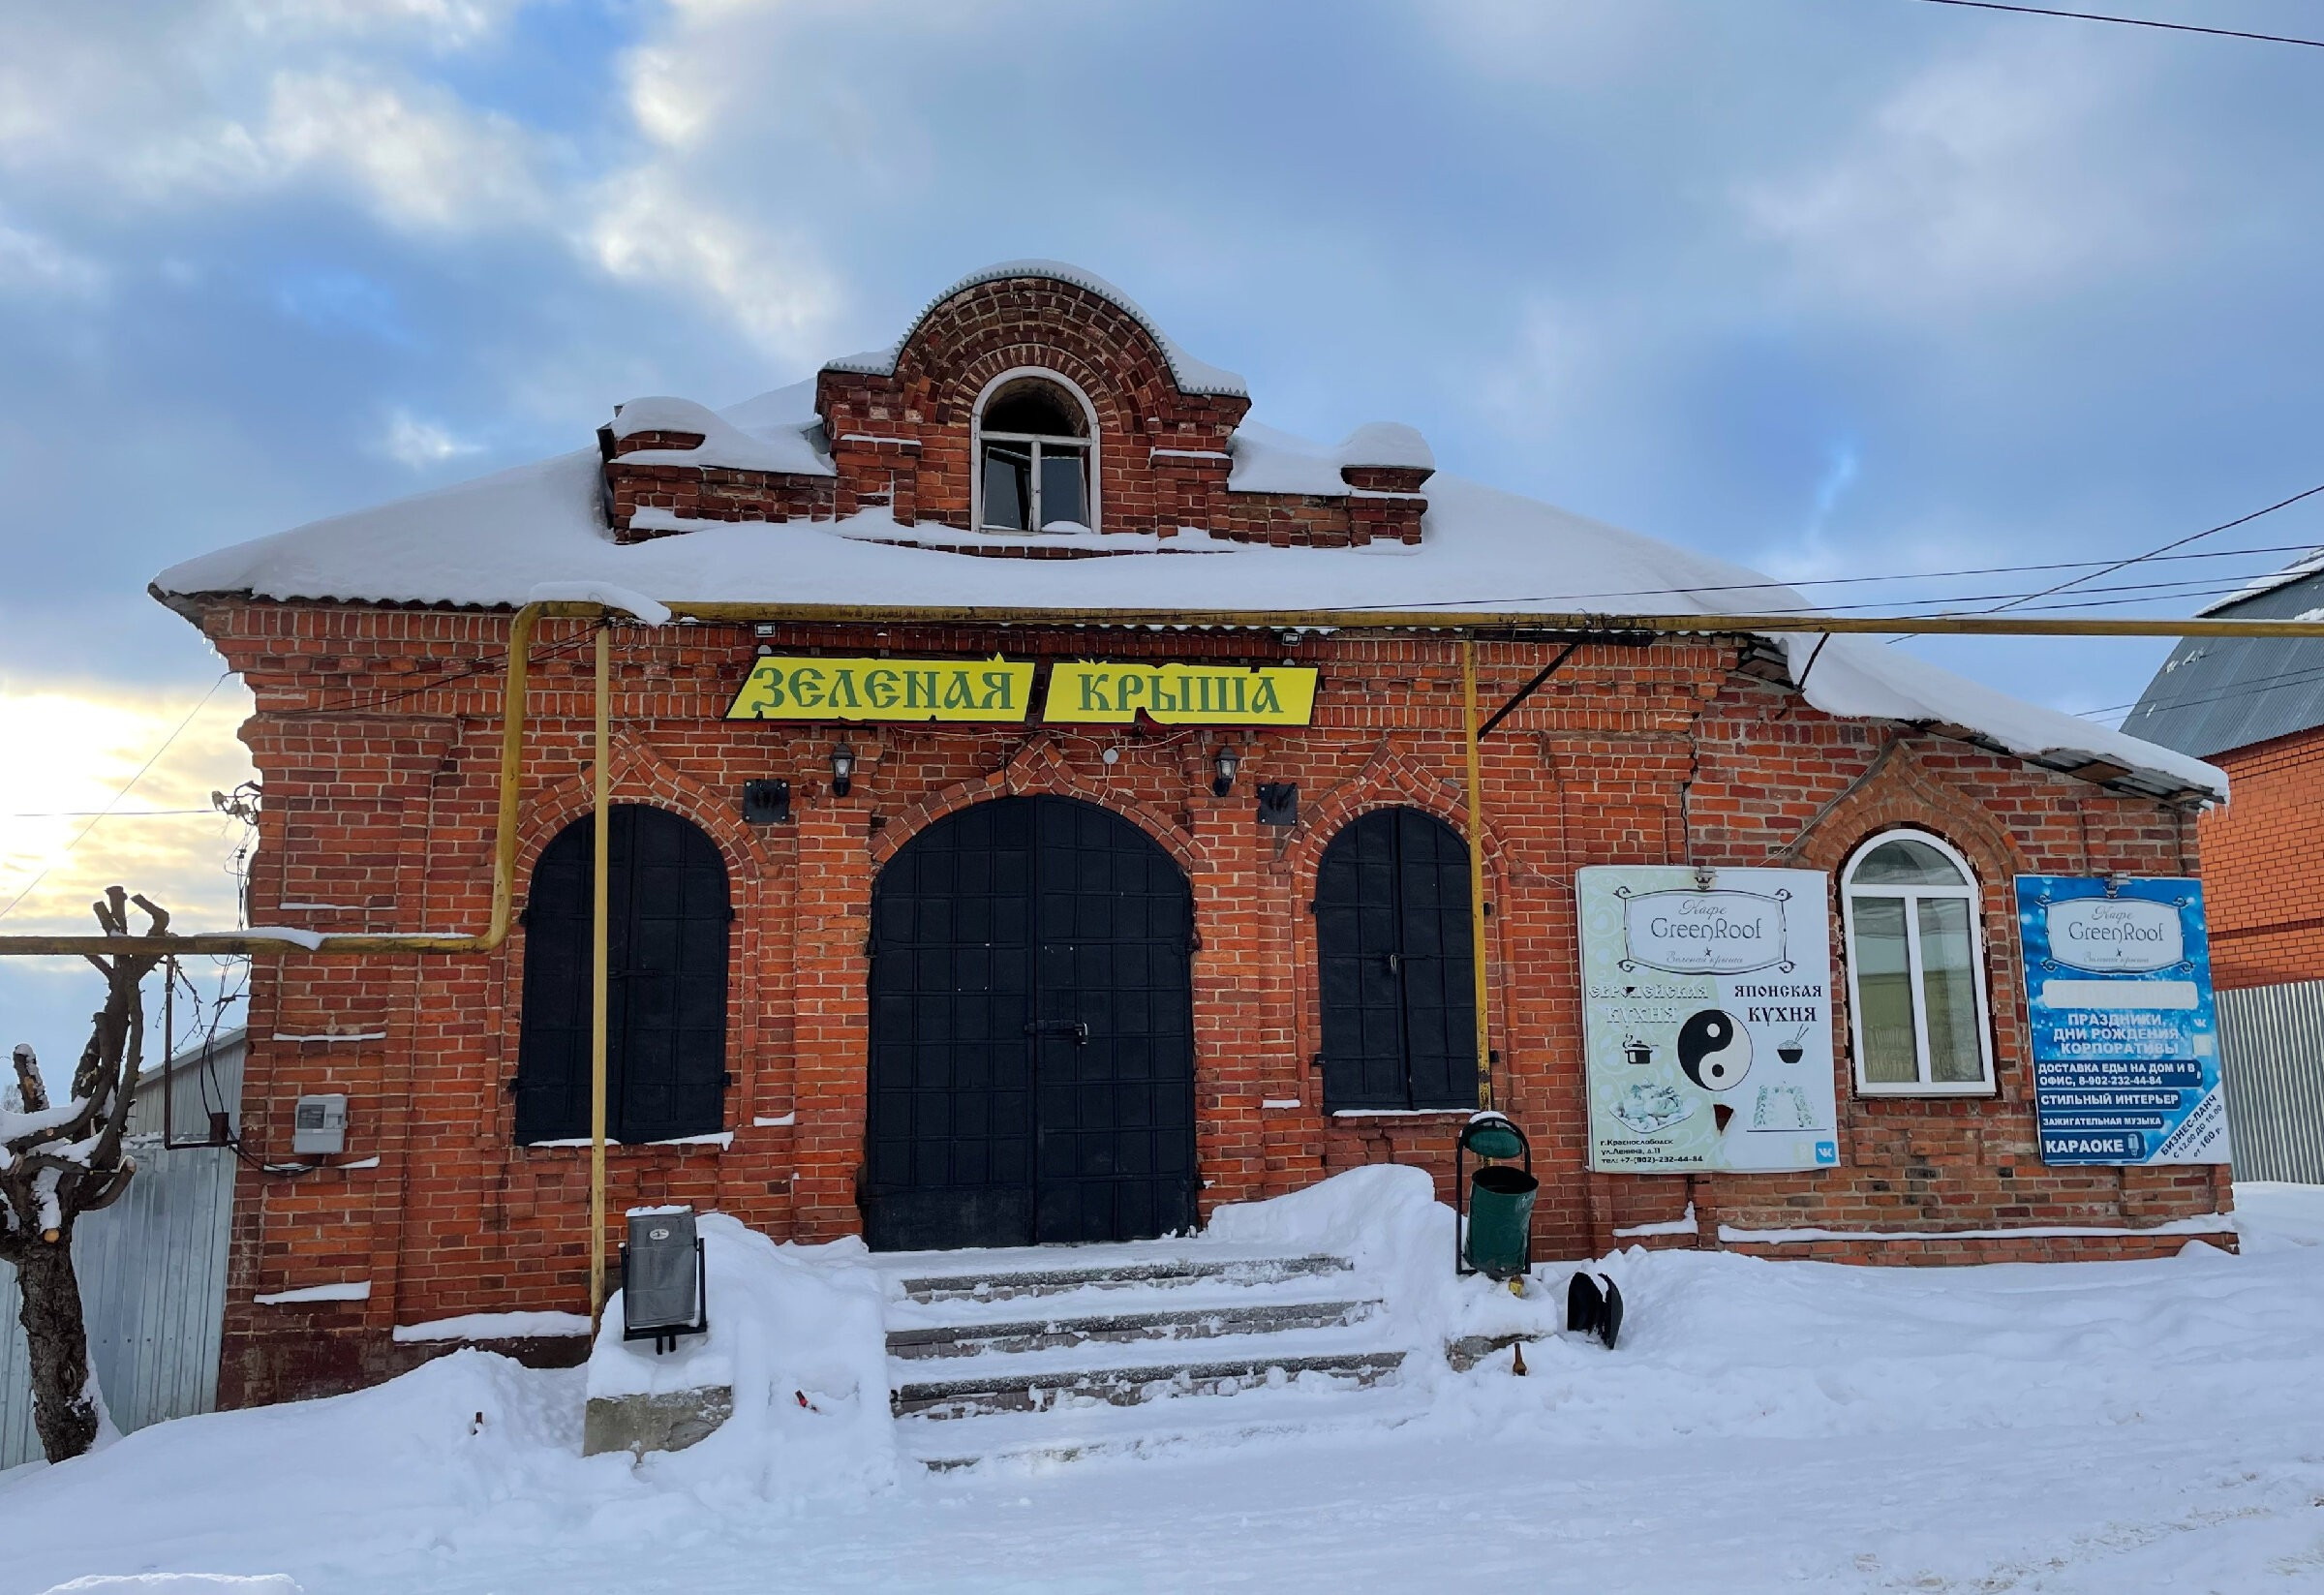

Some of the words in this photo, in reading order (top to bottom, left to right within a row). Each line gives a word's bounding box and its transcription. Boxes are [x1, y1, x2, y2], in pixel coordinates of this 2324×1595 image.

[751, 666, 1015, 712] ЗЕЛЕНАЯ
[1078, 673, 1284, 714] КРЫША
[1679, 900, 1728, 920] Кафе
[2092, 905, 2136, 924] Кафе
[1650, 917, 1763, 942] GreenRoof
[2068, 922, 2164, 943] GreenRoof
[1734, 985, 1822, 998] ЯПОНСКАЯ
[1747, 1007, 1818, 1027] КУХНЯ
[2053, 1028, 2087, 1042] ДНИ
[2061, 1043, 2179, 1055] КОРПОРАТИВЫ
[2038, 1063, 2099, 1074] ДОСТАВКА
[2102, 1063, 2127, 1074] ЕДЫ
[2130, 1063, 2146, 1073] НА
[2149, 1063, 2174, 1074] ДОМ
[2177, 1063, 2186, 1073] И
[2187, 1063, 2195, 1073] В
[2040, 1076, 2076, 1087] ОФИС,
[2079, 1076, 2162, 1086] 8-902-232-44-84
[2040, 1092, 2112, 1105] СТИЛЬНЫЙ
[2115, 1094, 2179, 1105] ИНТЕРЬЕР
[2043, 1118, 2122, 1126] ЗАЖИГАТЕЛЬНАЯ
[2125, 1118, 2161, 1126] МУЗЫКА
[2160, 1094, 2217, 1156] БИЗНЕС-ЛАНЧ
[2179, 1133, 2196, 1152] 12.00
[2206, 1104, 2222, 1123] 16.00
[2045, 1139, 2125, 1152] КАРАОКЕ
[2200, 1131, 2216, 1148] 160
